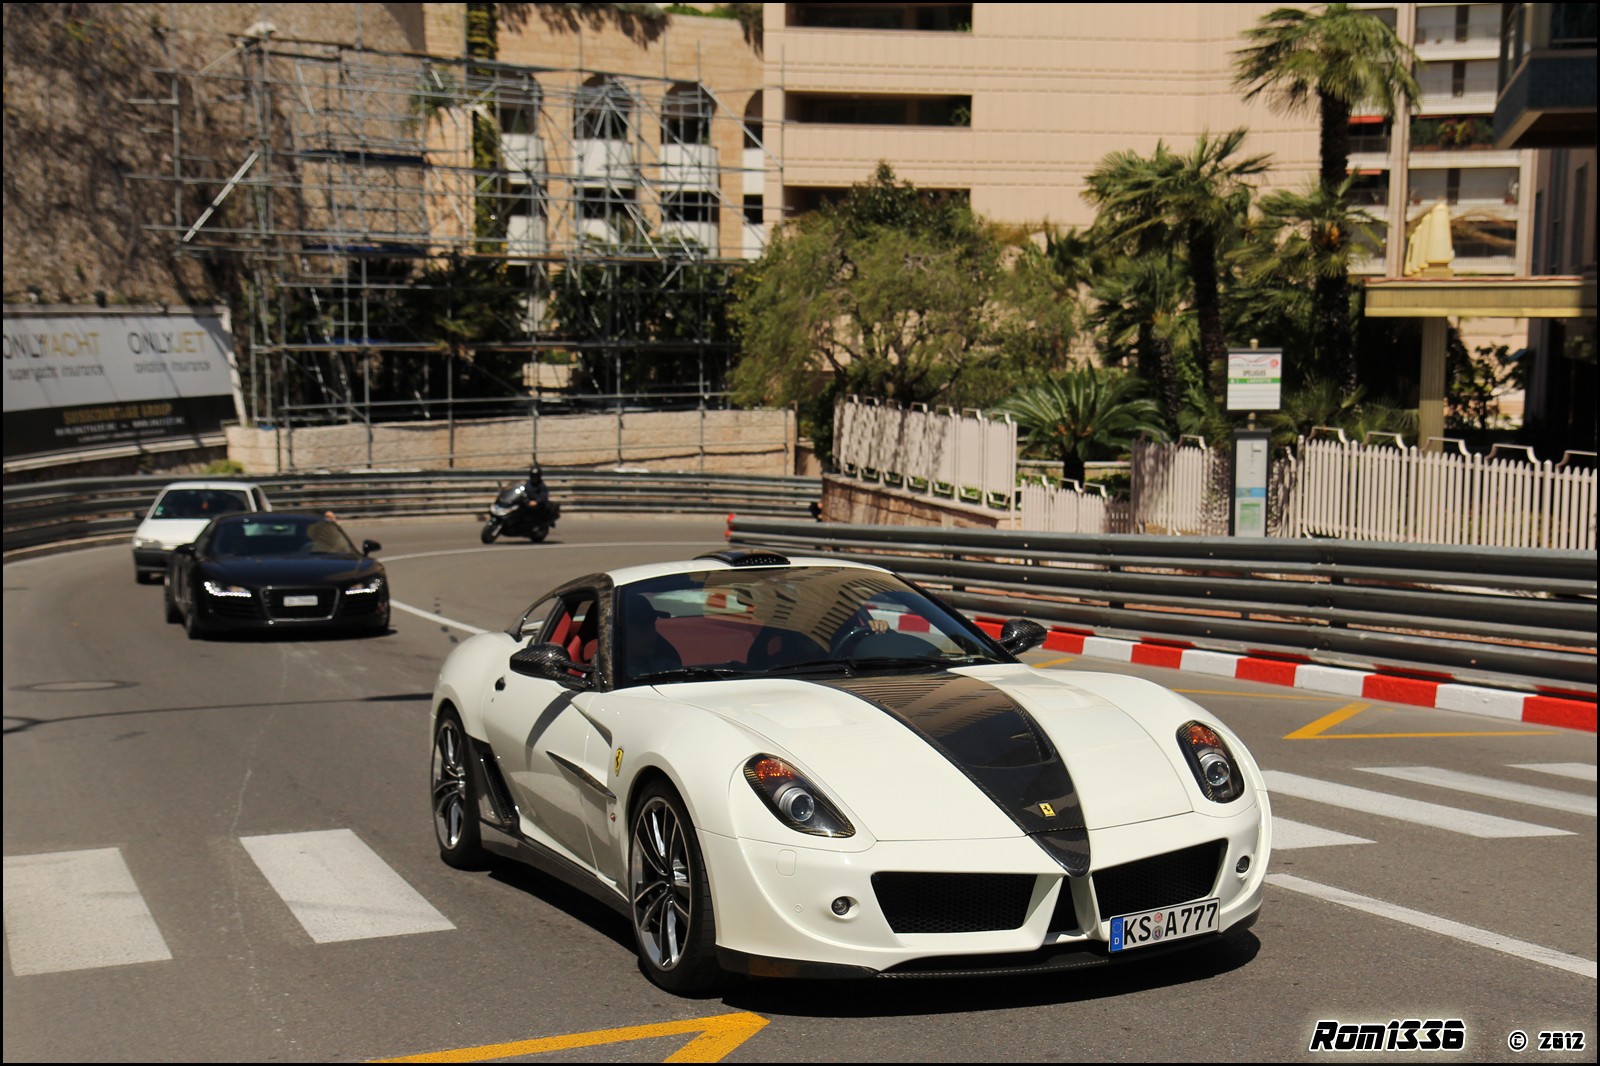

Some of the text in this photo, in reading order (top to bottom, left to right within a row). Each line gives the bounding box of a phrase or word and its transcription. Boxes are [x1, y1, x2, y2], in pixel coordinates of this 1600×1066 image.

[127, 330, 207, 354] ONLYJET
[1114, 937, 1120, 945] D
[1124, 915, 1151, 945] KS
